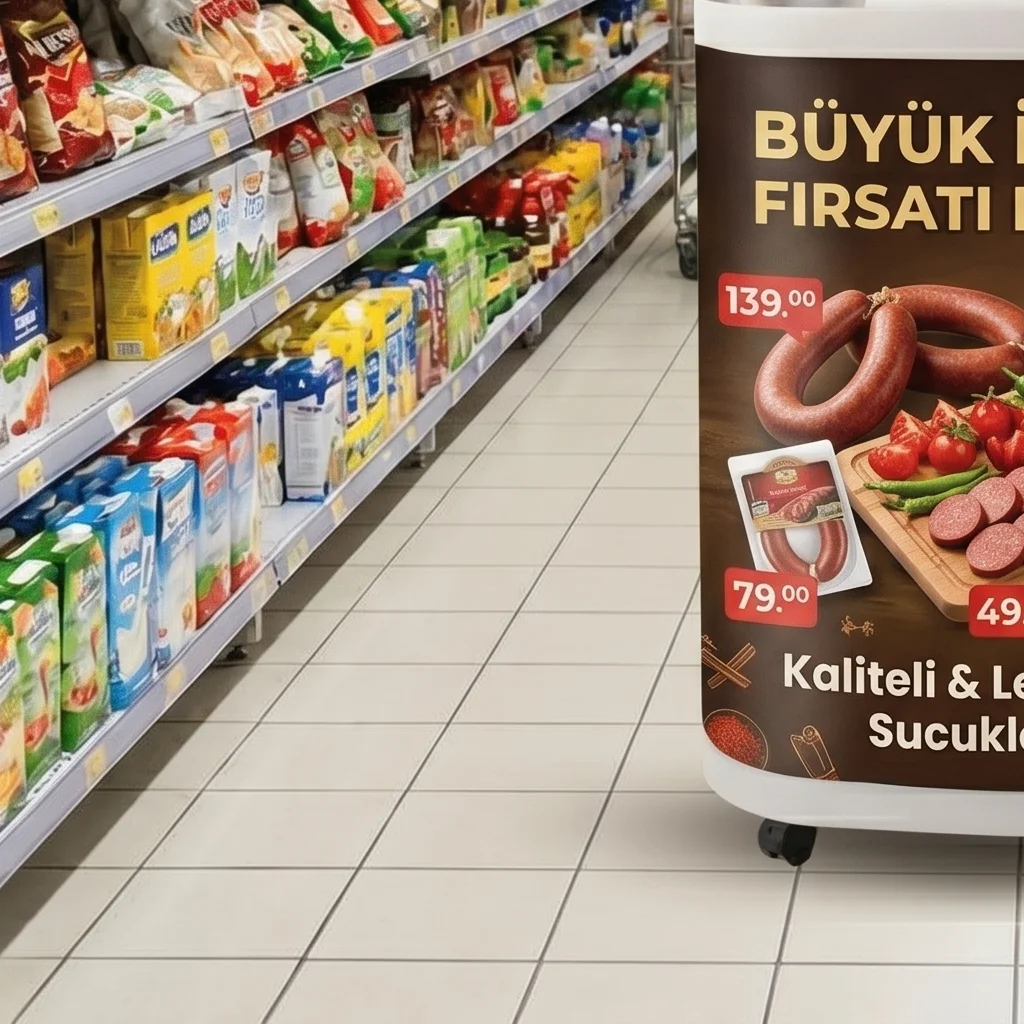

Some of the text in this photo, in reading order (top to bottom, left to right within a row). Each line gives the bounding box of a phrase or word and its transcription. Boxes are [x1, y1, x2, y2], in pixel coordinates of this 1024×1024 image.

[755, 98, 995, 164] BÜYÜK
[755, 179, 990, 231] FIRSATI
[725, 285, 816, 318] 139.00
[733, 580, 810, 613] 79.00
[784, 652, 936, 698] Kaliteli
[947, 663, 981, 700] &
